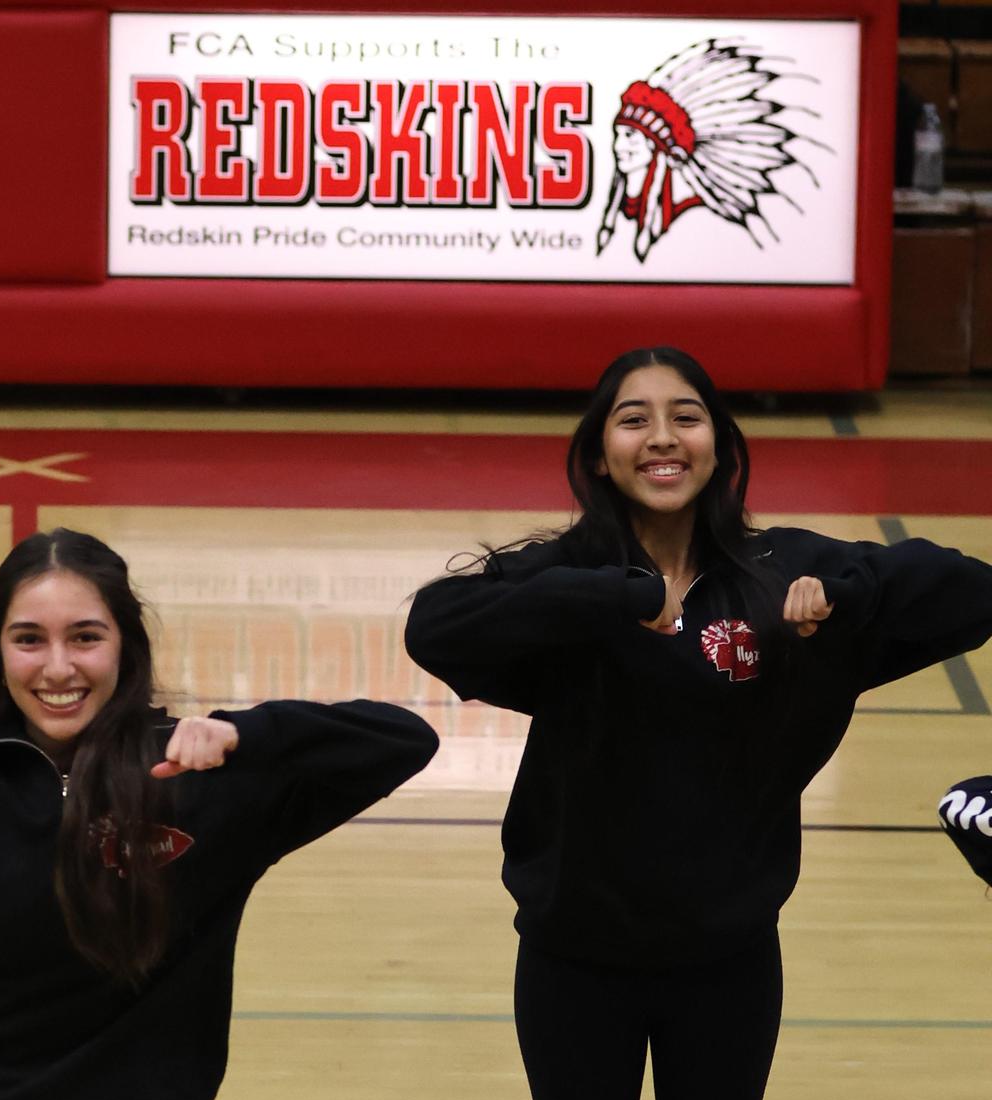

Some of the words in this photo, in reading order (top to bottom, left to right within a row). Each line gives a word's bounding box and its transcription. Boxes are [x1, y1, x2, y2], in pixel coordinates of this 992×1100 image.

[168, 31, 254, 58] FCA
[273, 33, 467, 62] Supports
[491, 36, 561, 59] The
[129, 74, 594, 210] REDSKINS
[126, 224, 243, 248] Redskin
[252, 226, 327, 248] Pride
[336, 226, 501, 252] Community
[511, 229, 584, 250] Wide
